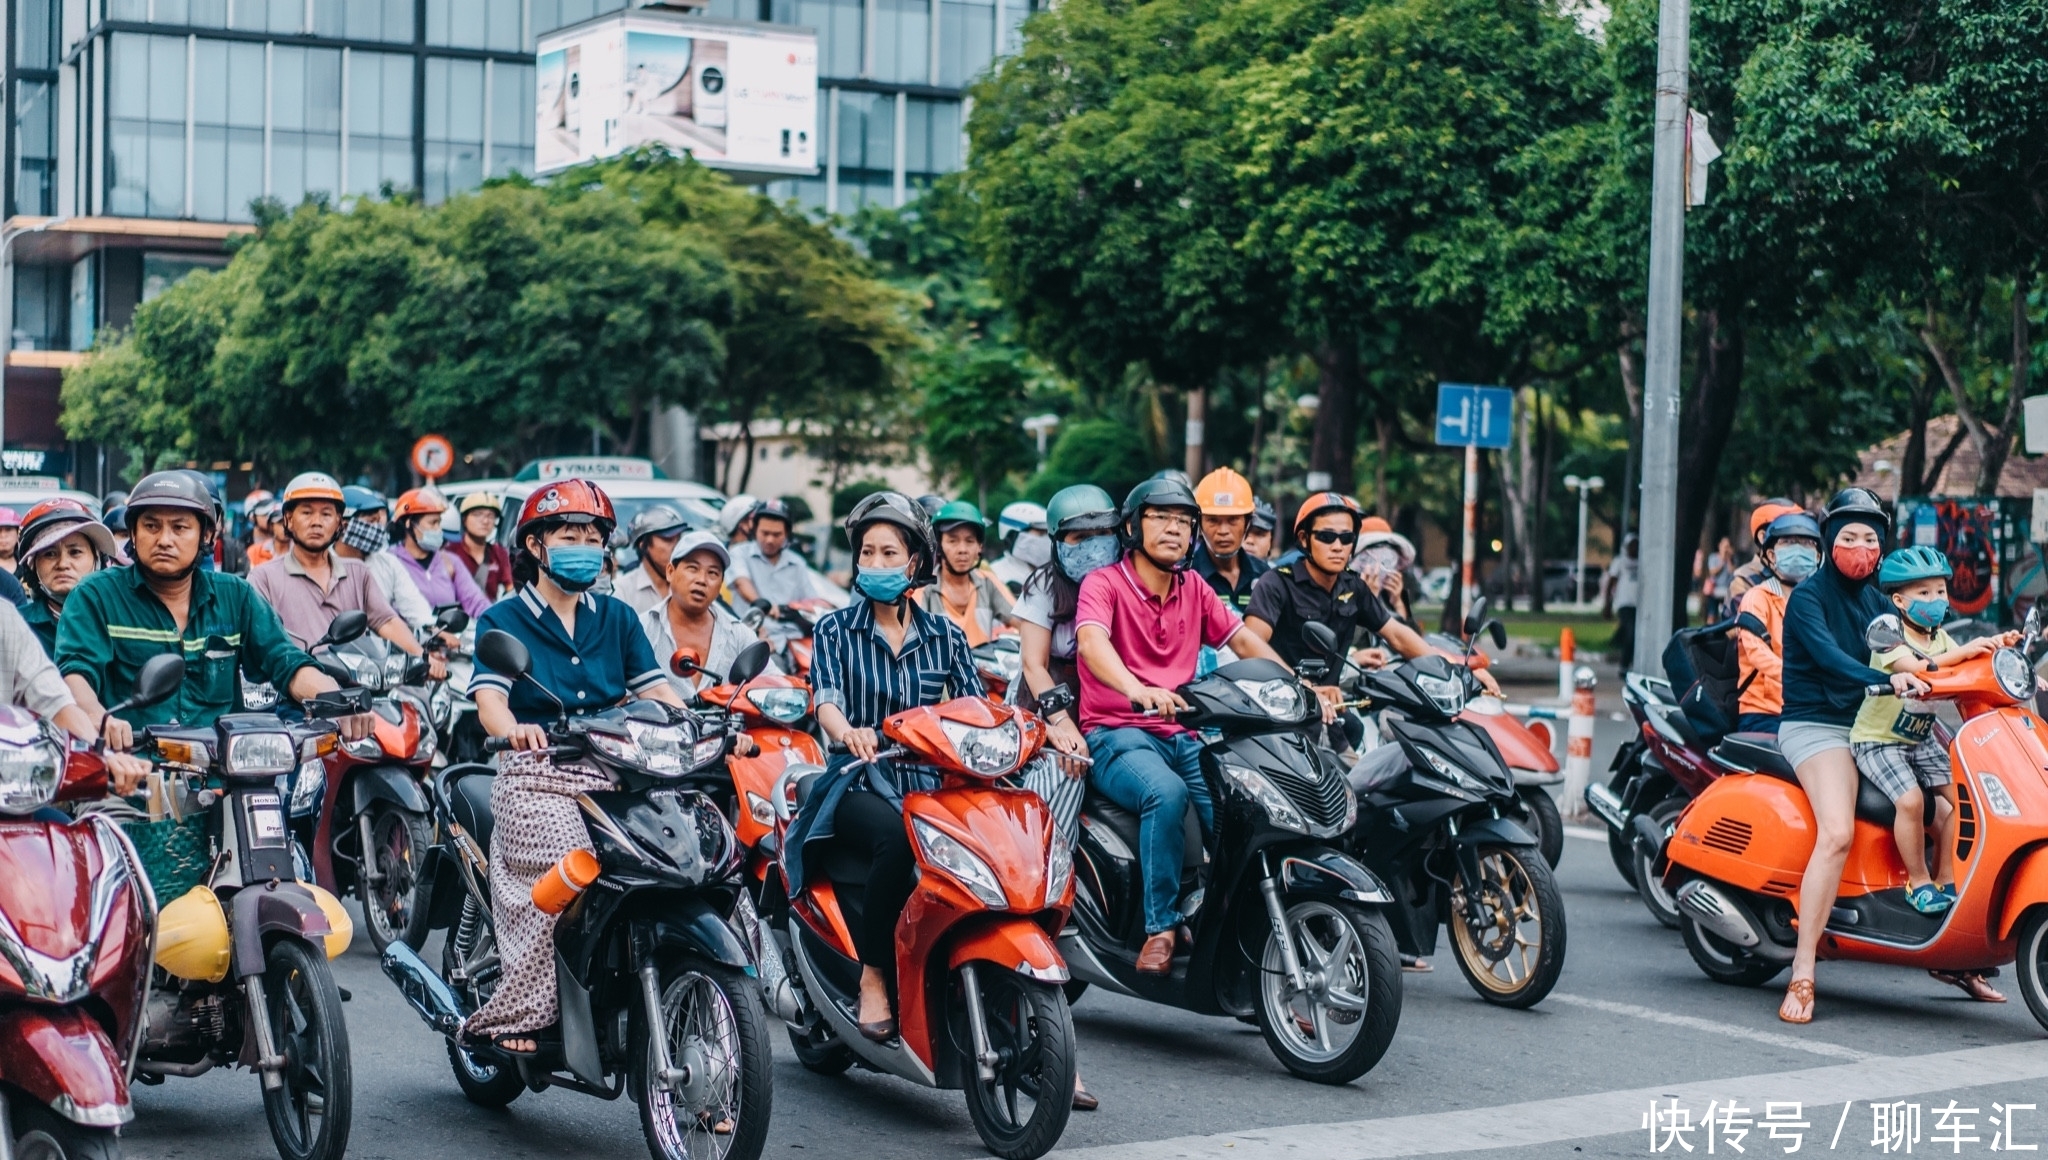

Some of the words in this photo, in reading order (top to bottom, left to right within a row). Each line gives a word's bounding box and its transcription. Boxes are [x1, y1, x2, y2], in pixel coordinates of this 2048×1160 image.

[565, 463, 619, 474] VINASUN
[1898, 711, 1931, 735] TIME
[597, 877, 625, 892] HONDA
